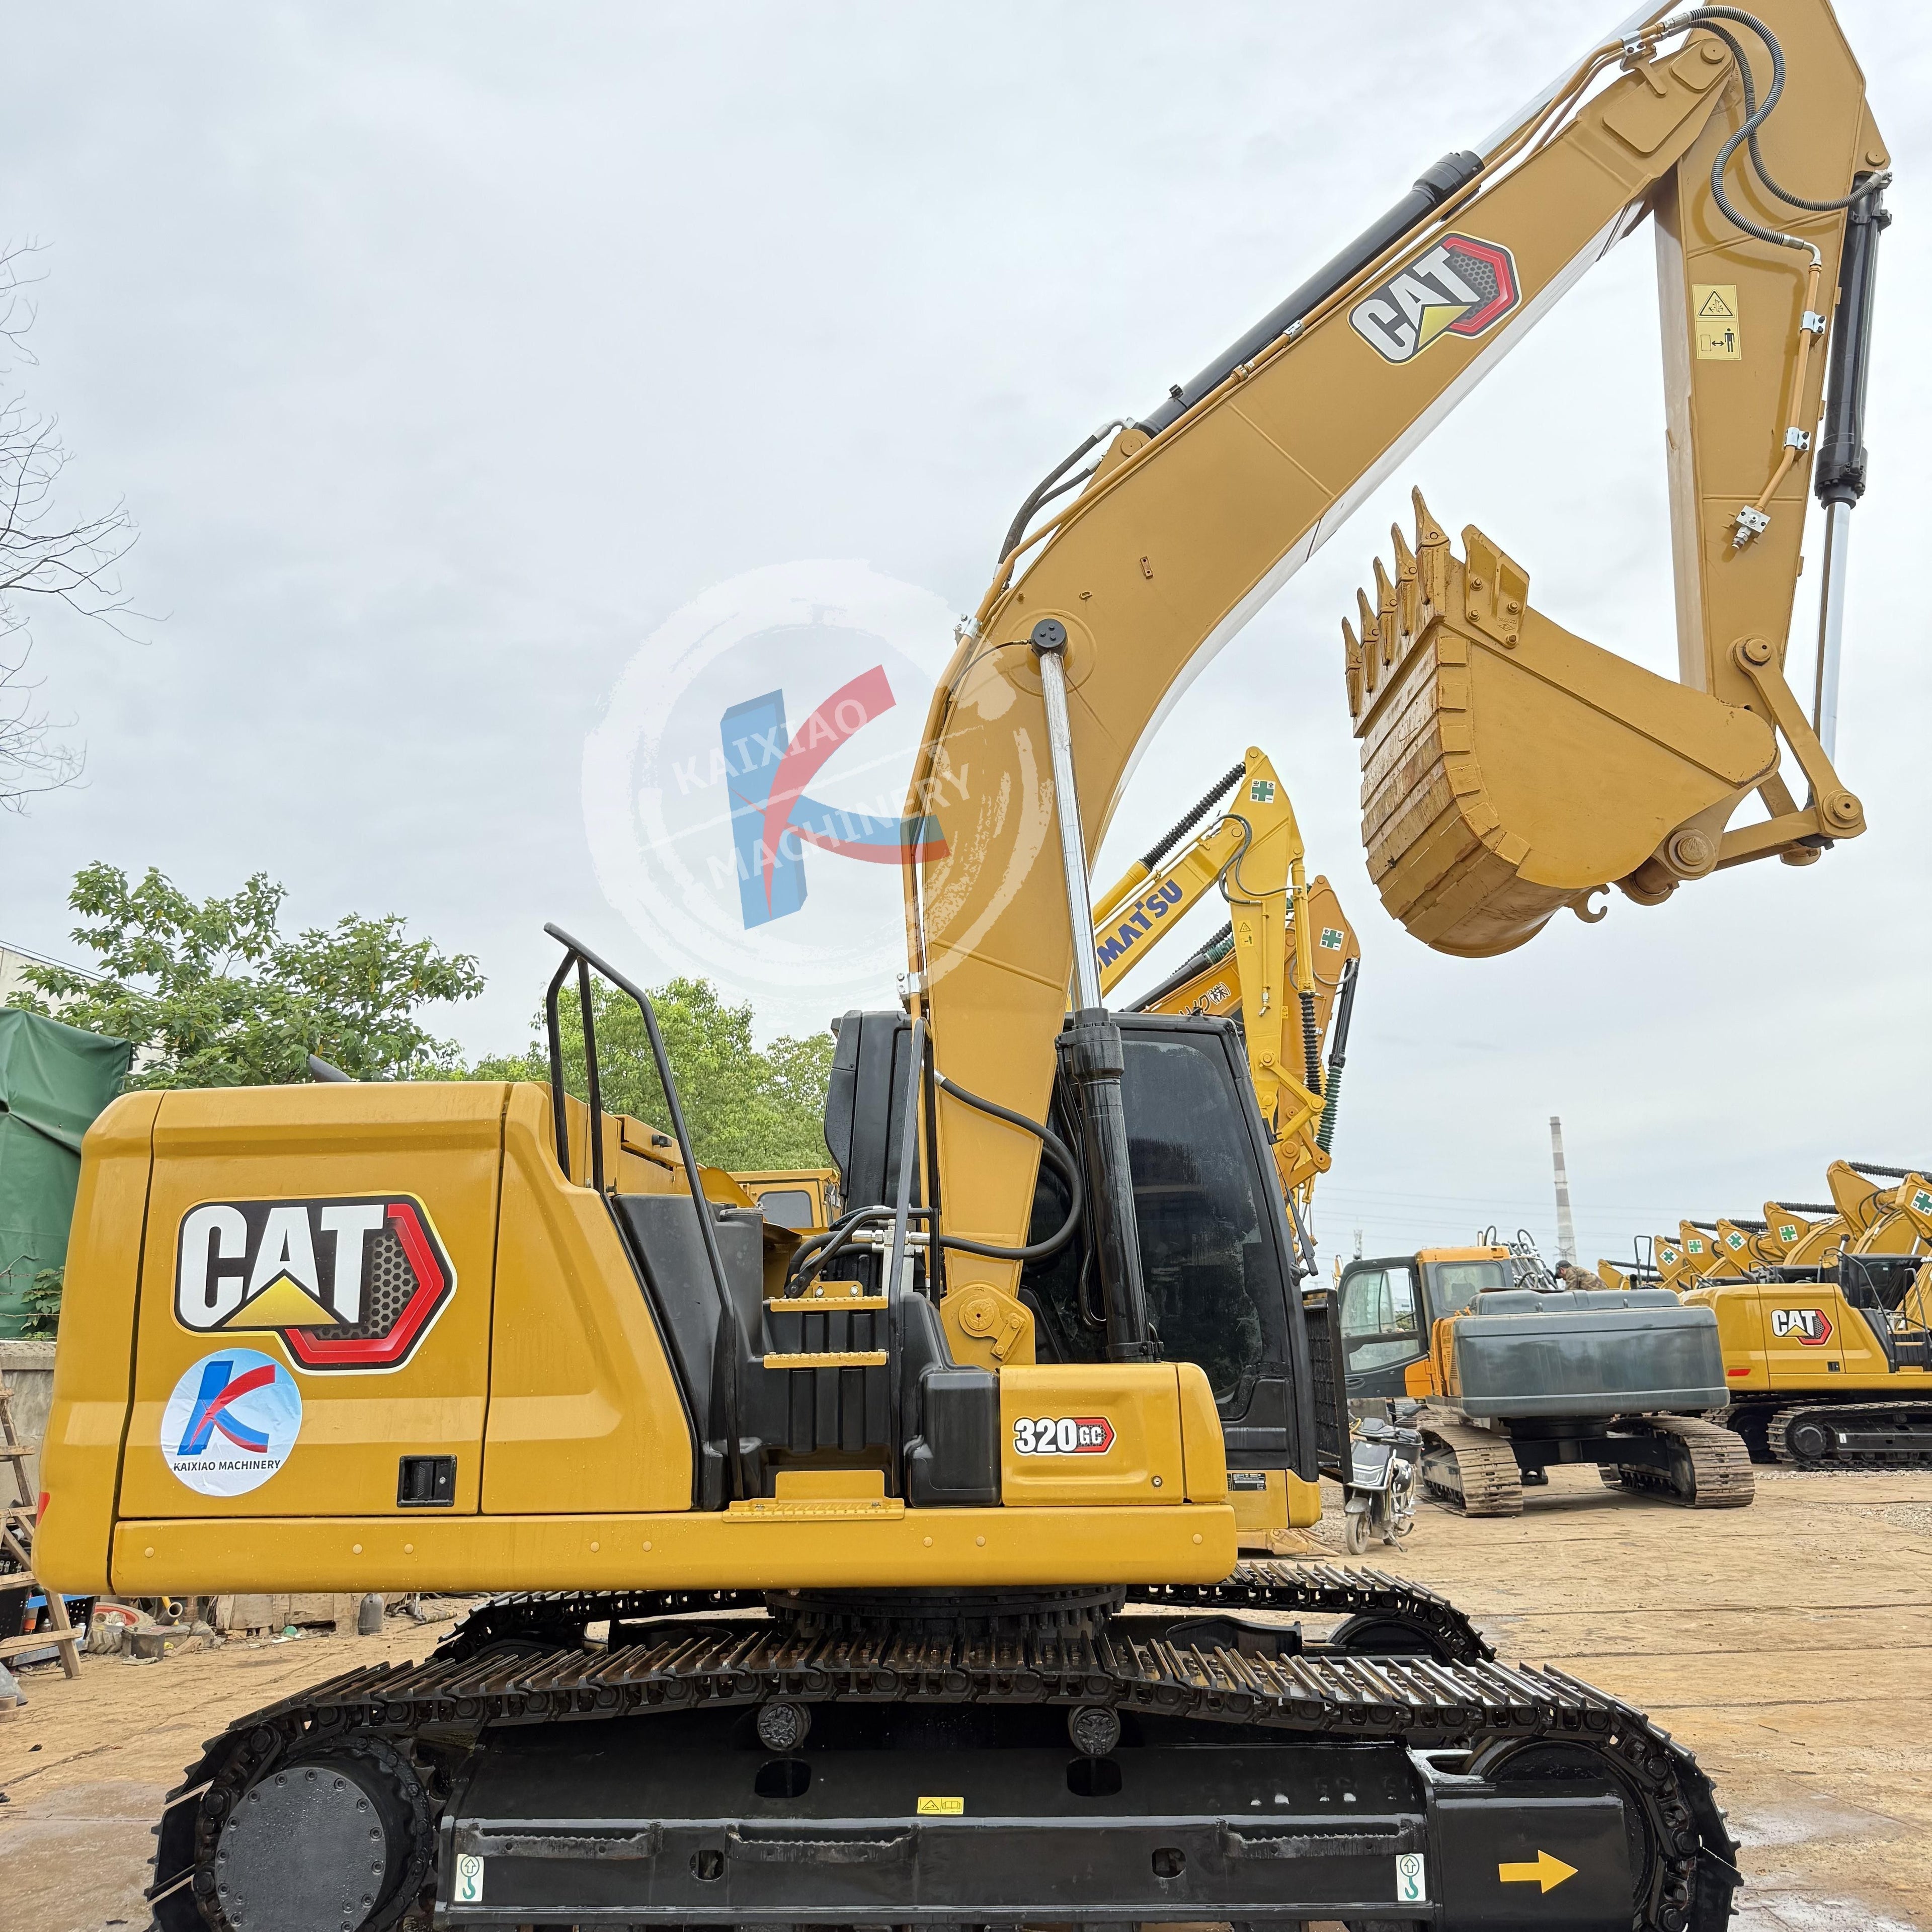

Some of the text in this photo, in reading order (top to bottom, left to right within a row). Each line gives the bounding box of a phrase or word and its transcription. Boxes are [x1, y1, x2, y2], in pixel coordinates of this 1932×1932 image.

[1352, 246, 1481, 360] CAT
[1097, 879, 1183, 975] MATSU
[179, 1204, 384, 1328] CAT
[1772, 1310, 1816, 1336] CAT
[174, 1460, 281, 1471] KAIXIAO MACHINERY
